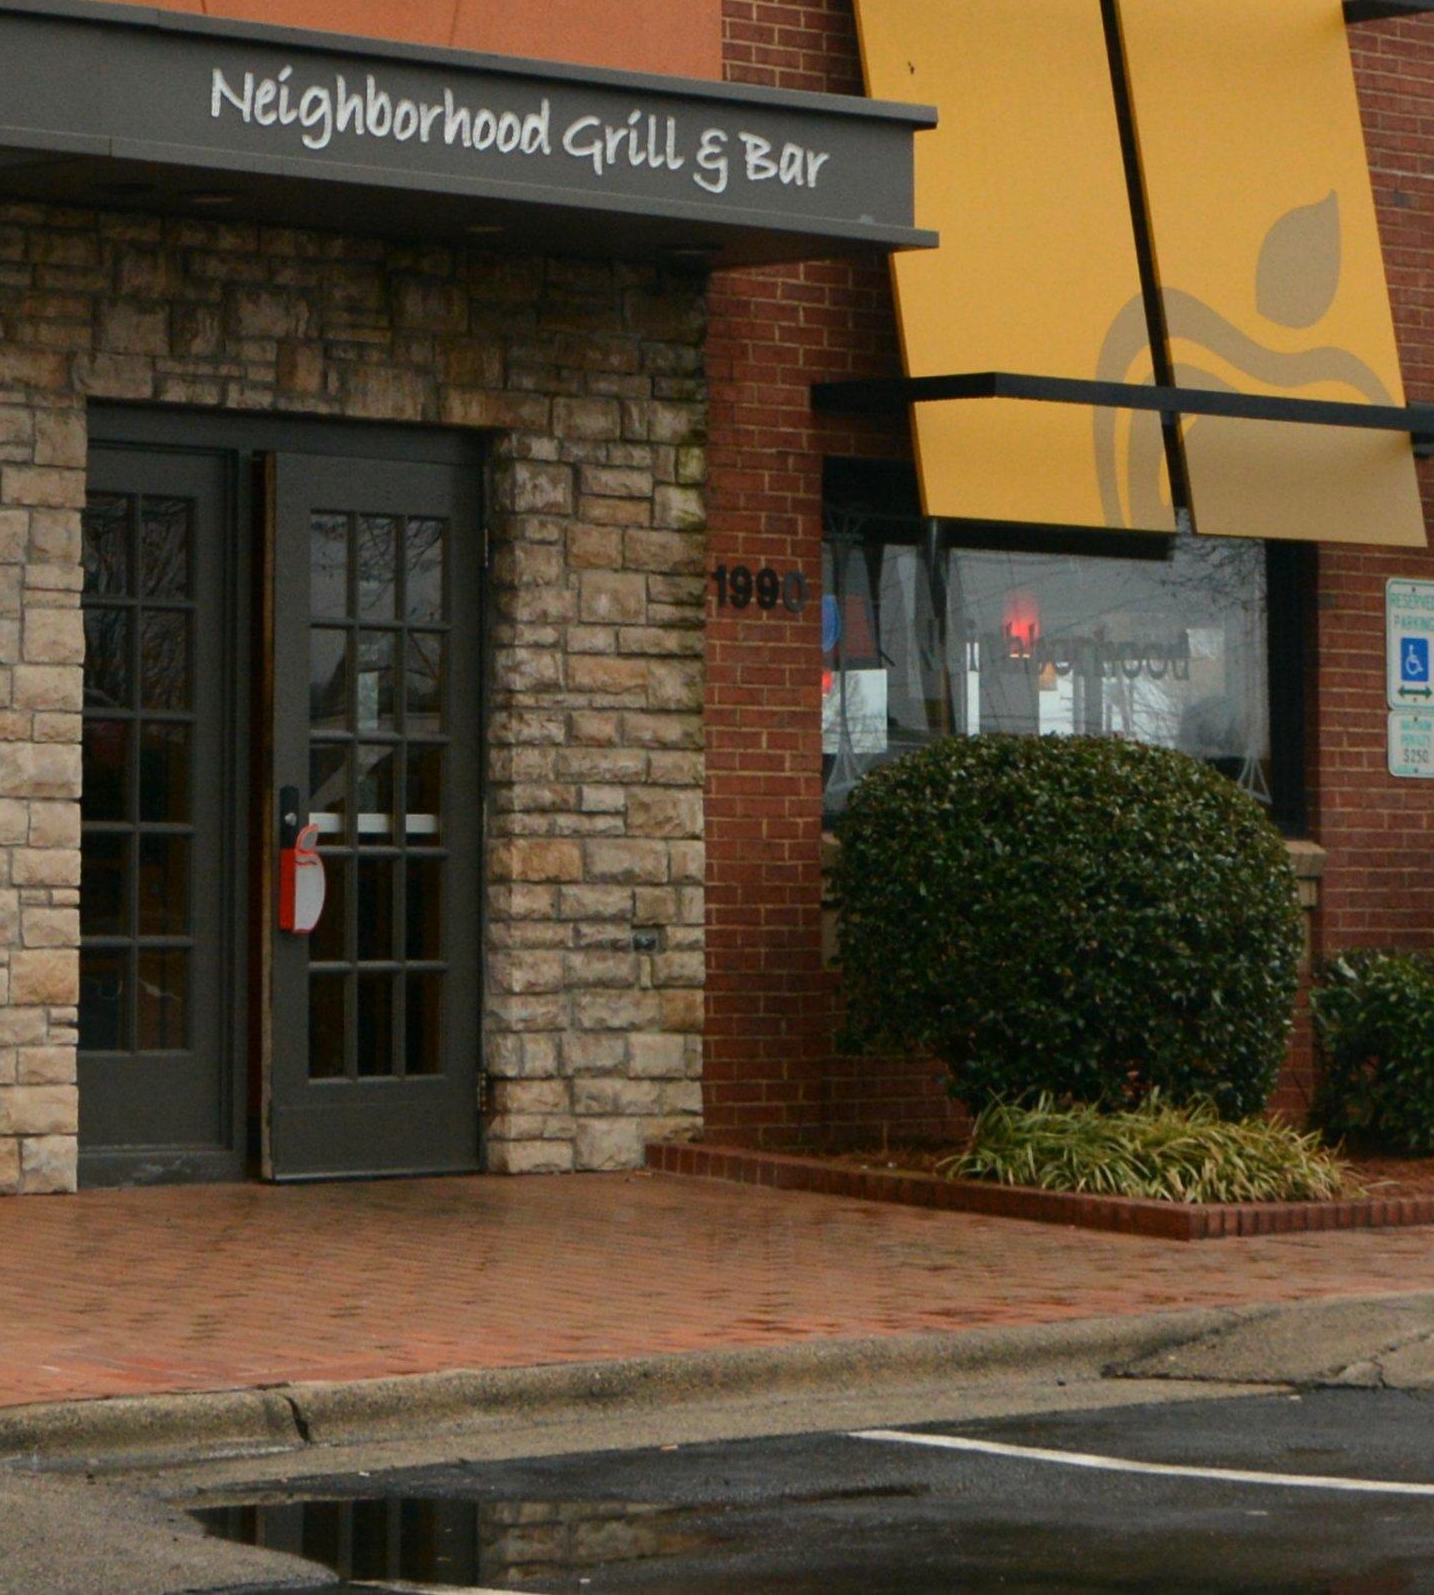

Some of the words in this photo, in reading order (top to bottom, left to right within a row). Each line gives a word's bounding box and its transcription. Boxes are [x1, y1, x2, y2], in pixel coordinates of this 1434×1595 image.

[210, 65, 551, 150] Neighborhood
[563, 109, 685, 175] Grill
[694, 127, 729, 194] &
[739, 131, 830, 189] Bar
